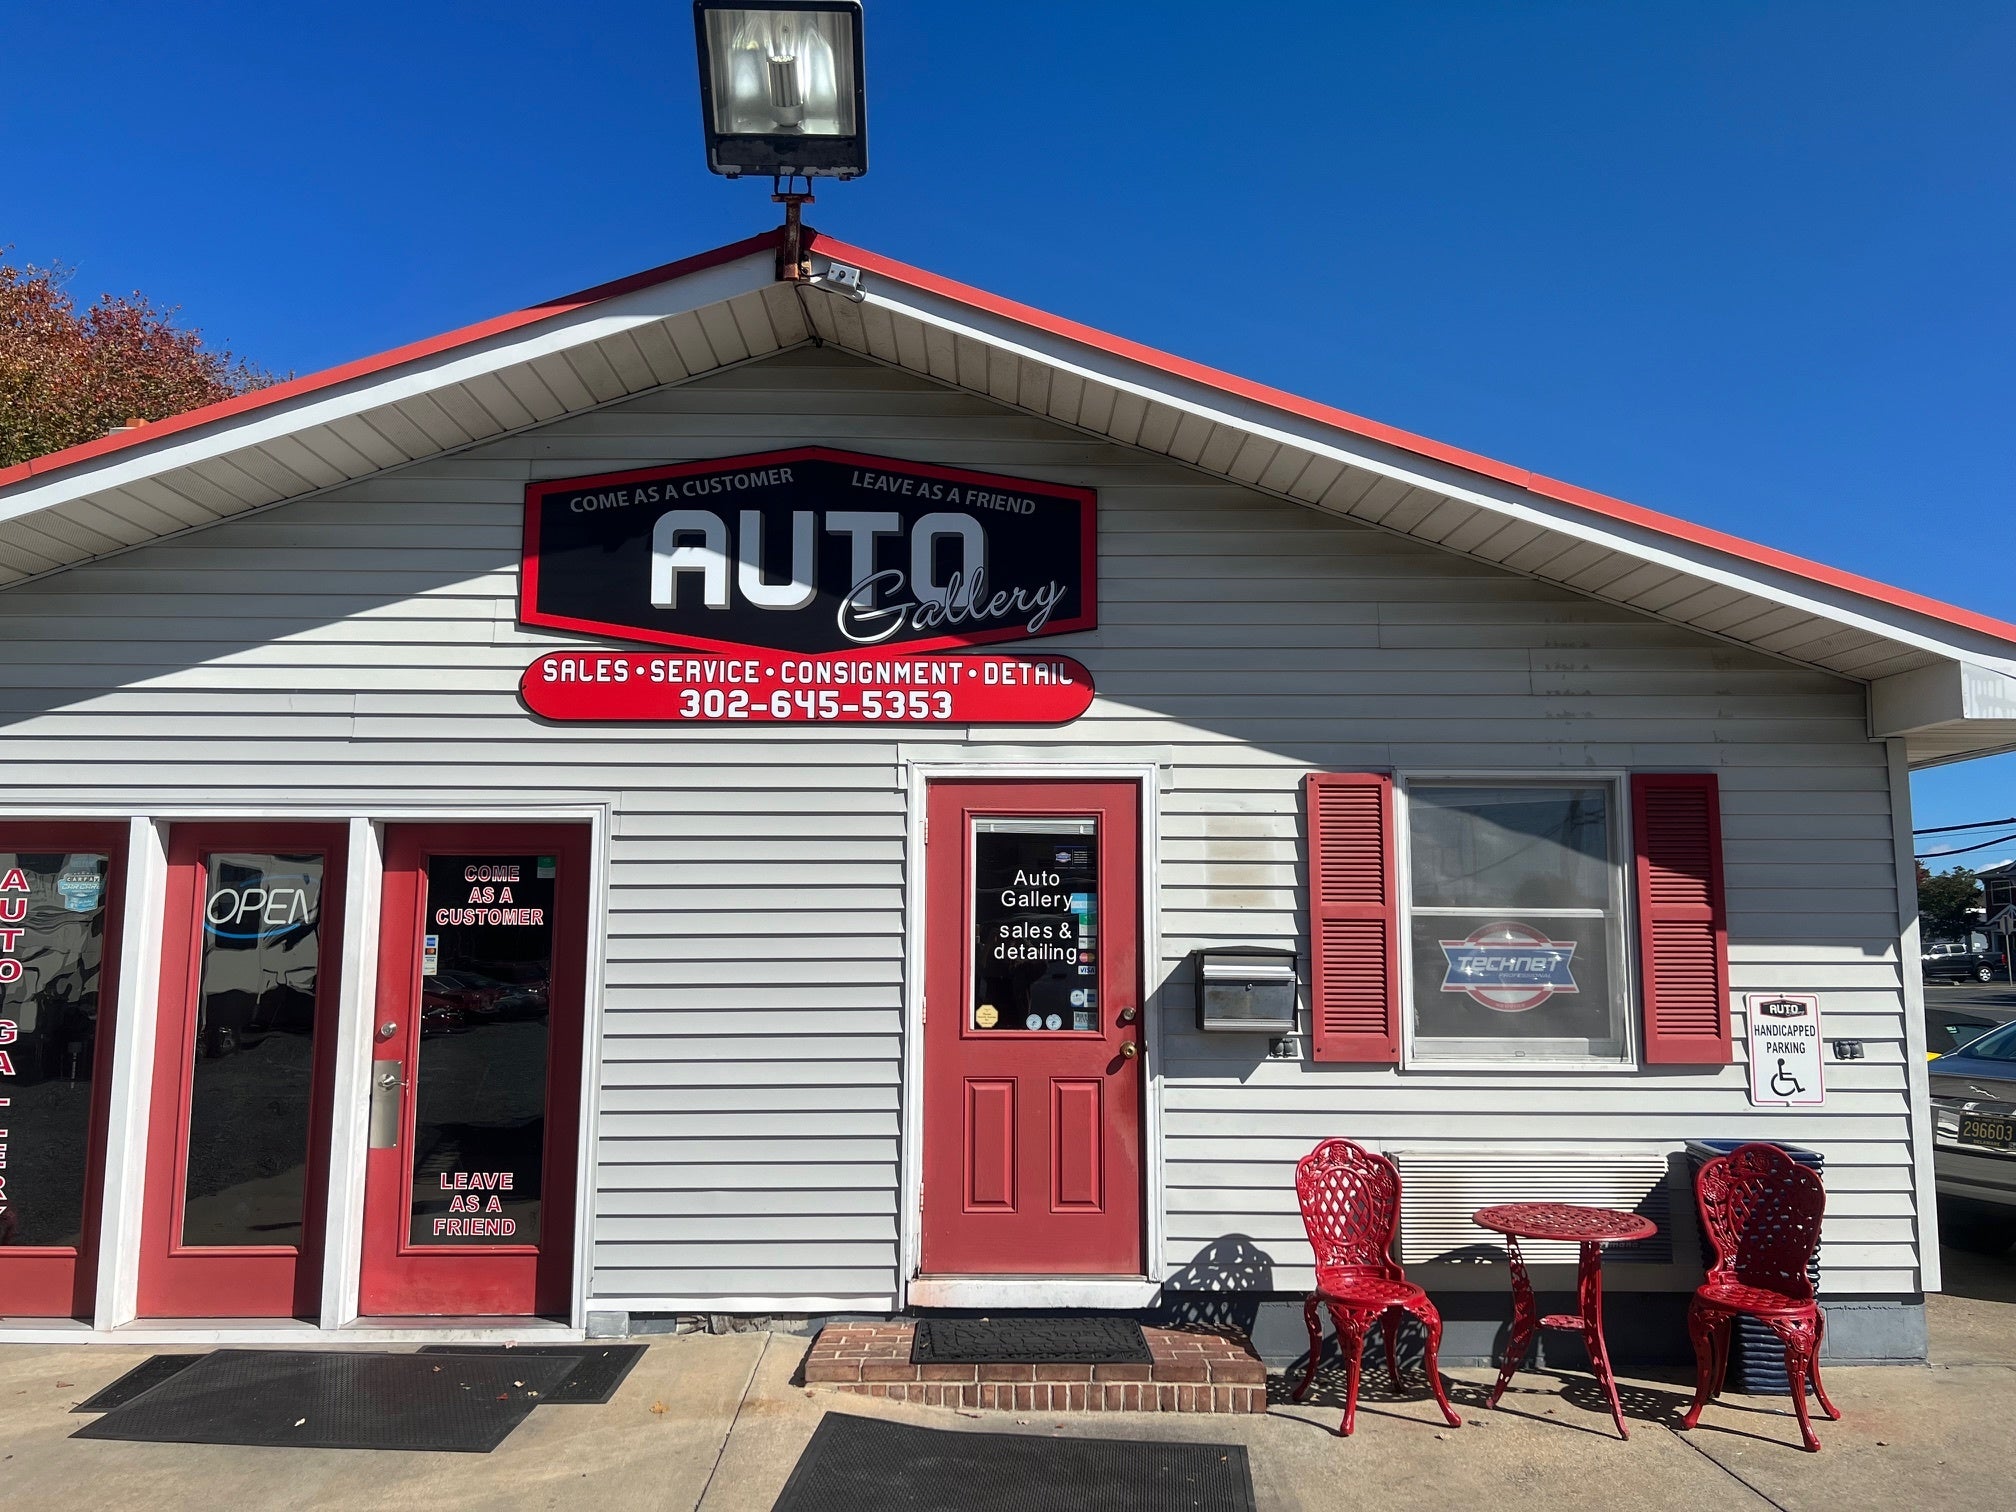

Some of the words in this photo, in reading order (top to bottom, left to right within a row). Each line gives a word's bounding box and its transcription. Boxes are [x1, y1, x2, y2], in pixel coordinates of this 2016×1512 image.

[570, 490, 629, 513] COME
[634, 486, 660, 504] AS
[665, 483, 679, 500] A
[682, 468, 794, 497] CUSTOMER
[851, 471, 914, 495] LEAVE
[916, 482, 943, 500] AS
[946, 487, 960, 503] A
[965, 490, 1036, 515] FRIEND
[651, 509, 987, 610] AUTO
[837, 566, 1066, 643] Gallery
[542, 659, 629, 683] SALES
[650, 659, 760, 684] SERVICE
[780, 660, 963, 685] CONSIGNMENT
[983, 661, 1074, 685] DETAIL
[678, 688, 953, 719] 302-645-5353
[464, 865, 520, 882] COME
[1013, 869, 1060, 886] Auto
[468, 886, 495, 904] AS
[499, 886, 513, 904] A
[1001, 890, 1073, 911] Gallery
[206, 888, 310, 925] OPEN
[0, 868, 31, 983] AUTO
[435, 908, 544, 926] CUSTOMER
[999, 921, 1052, 938] sales
[1059, 922, 1072, 939] &
[993, 943, 1077, 964] detailing
[1769, 1004, 1798, 1014] AUTO
[1754, 1025, 1816, 1037] HANDICAPPED
[1766, 1042, 1806, 1054] PARKING
[1963, 1121, 2013, 1141] 296603
[440, 1172, 514, 1190] LEAVE
[448, 1194, 480, 1213] AS
[485, 1194, 502, 1213] A
[433, 1218, 516, 1236] FRIEND
